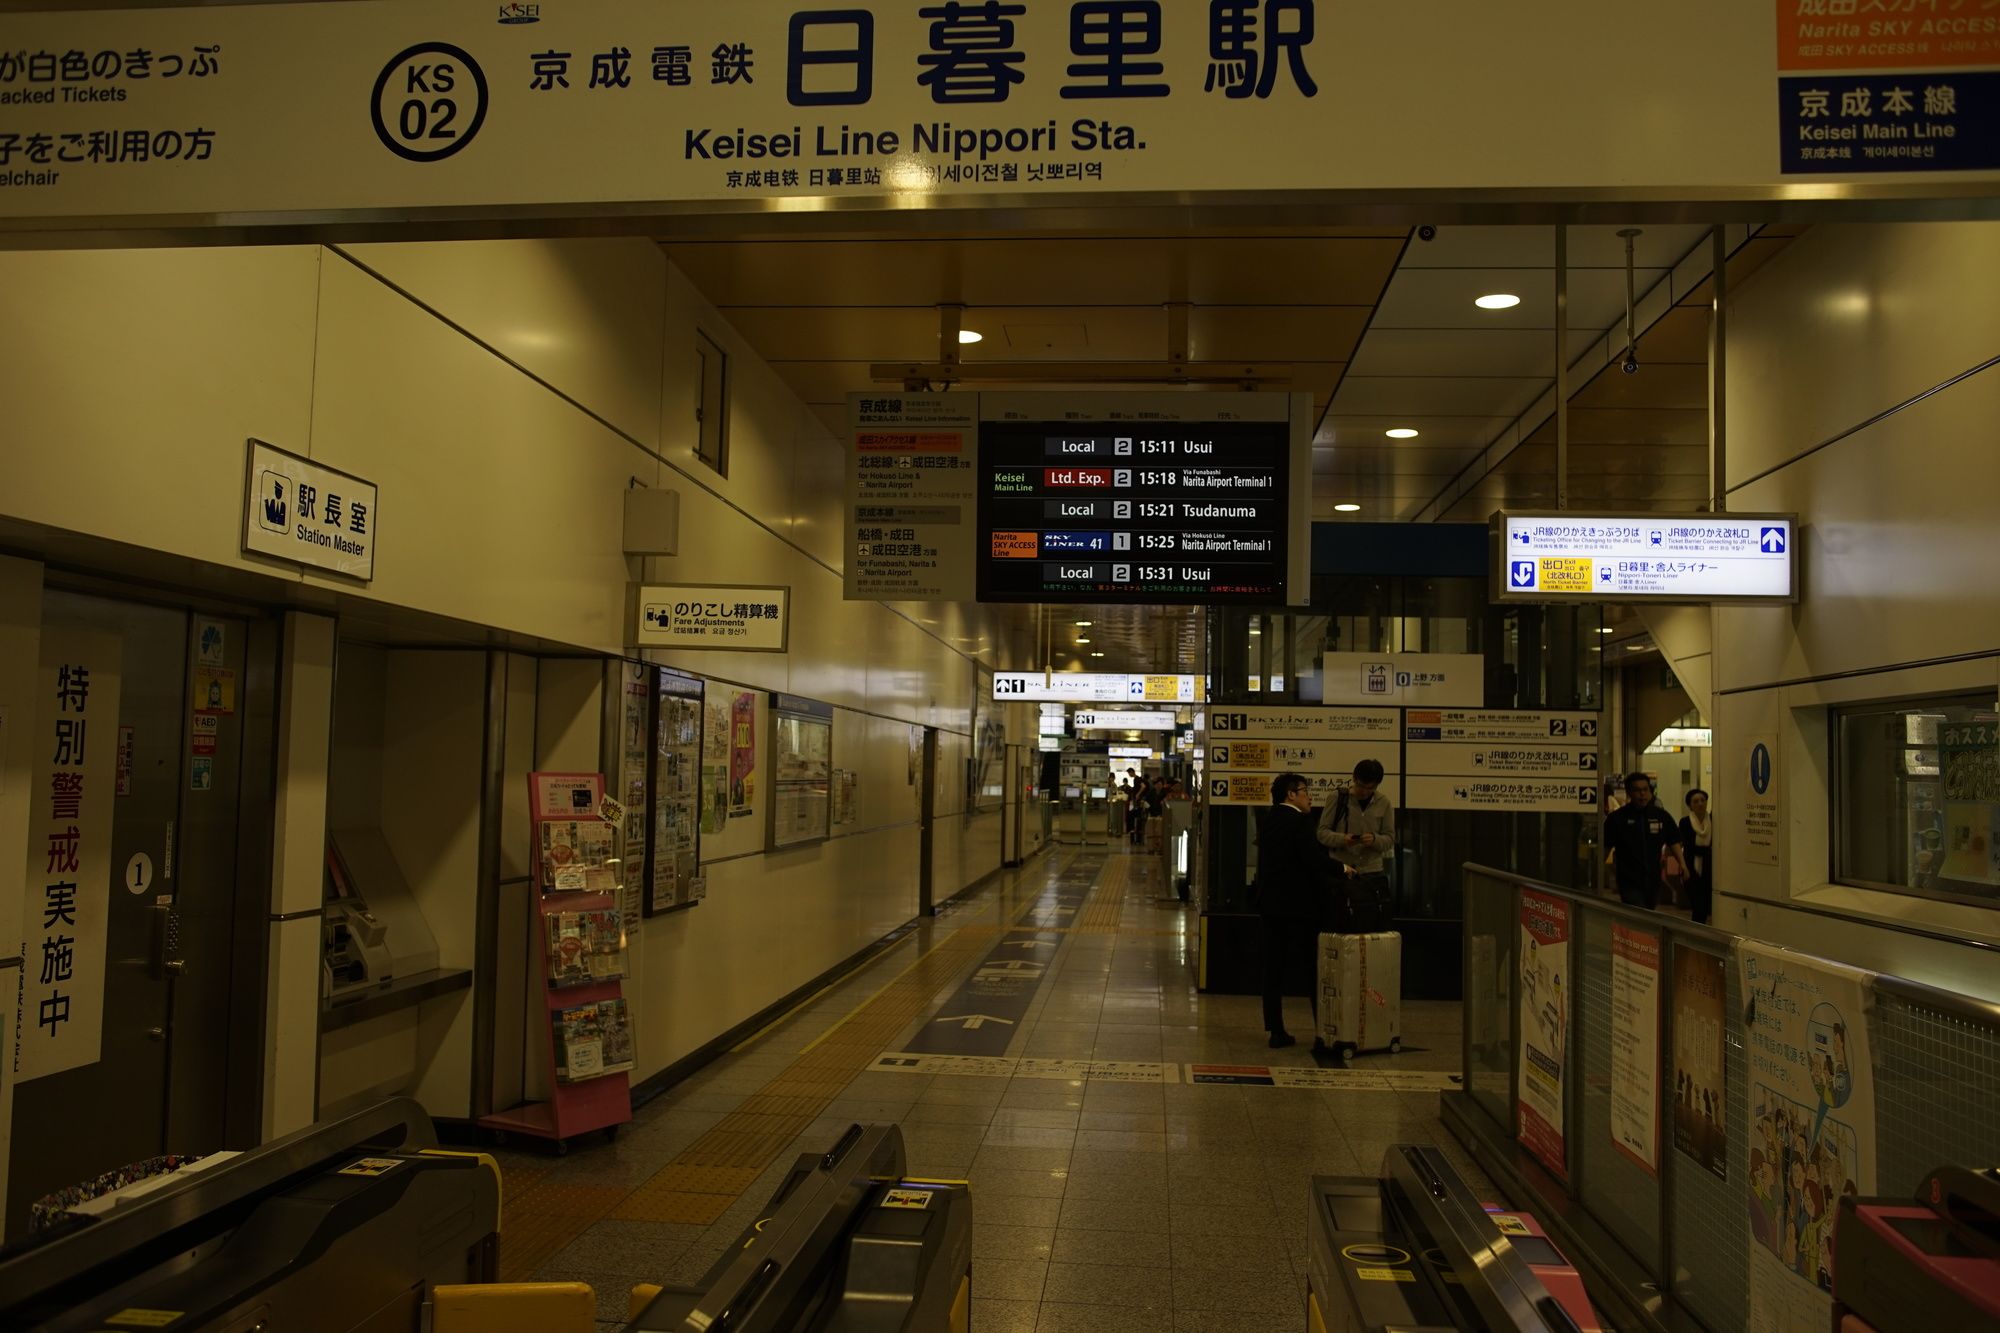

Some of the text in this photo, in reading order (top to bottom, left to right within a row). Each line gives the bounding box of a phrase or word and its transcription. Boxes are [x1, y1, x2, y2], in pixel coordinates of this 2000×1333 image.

[1799, 17, 2000, 38] Narita SKY ACCES
[530, 0, 1318, 106] 京成電鉄 日暮里駅
[0, 45, 220, 82] が白色のきっぷ
[407, 64, 455, 93] KS
[62, 86, 127, 102] Tickets
[1798, 85, 1957, 118] 京成本線
[400, 99, 457, 140] 02
[1800, 122, 1956, 140] Keisei Main Line
[0, 128, 215, 165] 子をご利用の方
[685, 119, 1146, 160] Keisei Line Nippori Sta.
[726, 161, 1102, 188] 京成电铁 日暮里站 닛뽀리역
[859, 400, 902, 414] 京成線
[1062, 440, 1213, 454] Local 2 15:11 Usui
[858, 472, 868, 480] for
[898, 472, 914, 480] Line
[994, 473, 1025, 483] Keisei
[1051, 473, 1075, 485] Ltd.
[1079, 473, 1105, 487] Exp.
[1118, 473, 1129, 484] 2
[1140, 472, 1176, 485] 15:18
[1182, 475, 1204, 487] Narita
[1205, 476, 1232, 489] Airport
[1233, 476, 1267, 488] Terminal
[866, 481, 913, 490] Narita Airport
[994, 484, 1033, 492] Main Line
[297, 484, 367, 534] 駅長室
[1061, 504, 1256, 518] Local 2 15:21 Tsudanuma
[297, 524, 364, 557] Station Master
[857, 528, 915, 541] 船橋・成田
[994, 533, 1017, 541] Narita
[1668, 528, 1750, 539] JR線のりかえ改札口
[994, 541, 1036, 549] SKY ACCESS
[1090, 538, 1103, 549] 41
[1138, 535, 1174, 548] 15:25
[1182, 540, 1204, 551] Narita
[1205, 540, 1231, 553] Airport
[1232, 540, 1265, 552] Terminal
[994, 549, 1010, 557] Line
[869, 560, 907, 569] Funabashi,
[1542, 560, 1563, 570] 出口
[1619, 562, 1718, 573] 日暮里・舎人ライナー
[865, 569, 913, 578] Narita Airport
[1060, 566, 1211, 580] Local 2 15:31 Usui
[675, 602, 778, 620] のりこし精算機
[674, 617, 745, 627] Fare Adjustments
[1413, 673, 1445, 682] 上野 方面
[201, 718, 217, 727] AED
[1249, 715, 1323, 723] SKYLINER
[1552, 721, 1564, 736] 2
[1233, 744, 1248, 752] 出口
[1488, 751, 1569, 761] JR線のりかえ改札口
[1233, 777, 1248, 786] 出口
[39, 664, 89, 1037] 特別警戒実施中
[134, 862, 144, 886] 1
